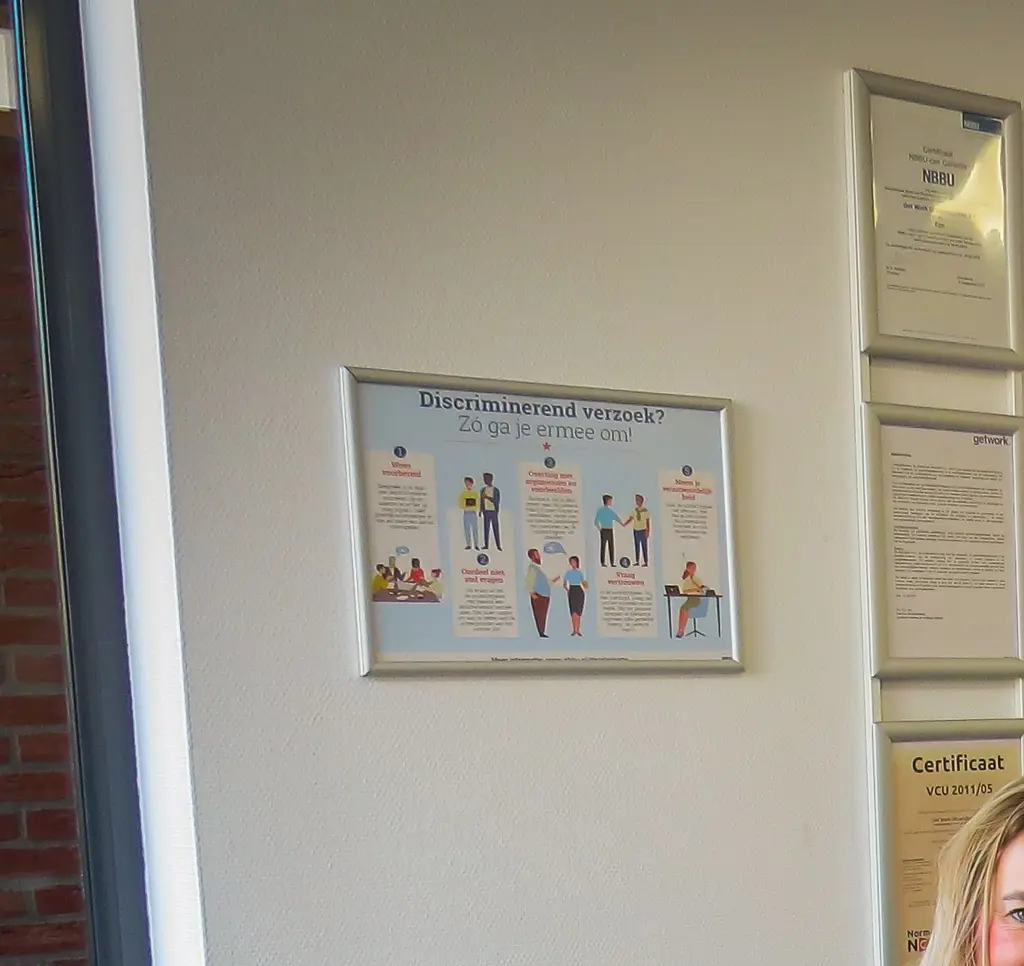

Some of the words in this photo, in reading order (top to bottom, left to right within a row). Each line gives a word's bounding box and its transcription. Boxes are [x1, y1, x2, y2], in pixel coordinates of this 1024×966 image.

[922, 168, 955, 187] NBBU
[418, 390, 577, 418] Discriminerend
[582, 407, 665, 424] verzoek?
[458, 415, 483, 433] Zó
[488, 420, 511, 438] ga
[515, 417, 531, 439] je
[537, 422, 595, 441] ermee
[600, 427, 633, 443] om!
[912, 754, 1005, 774] Certificaat
[926, 785, 949, 796] VCU
[952, 781, 993, 797] 2011/05
[907, 929, 931, 938] Norm
